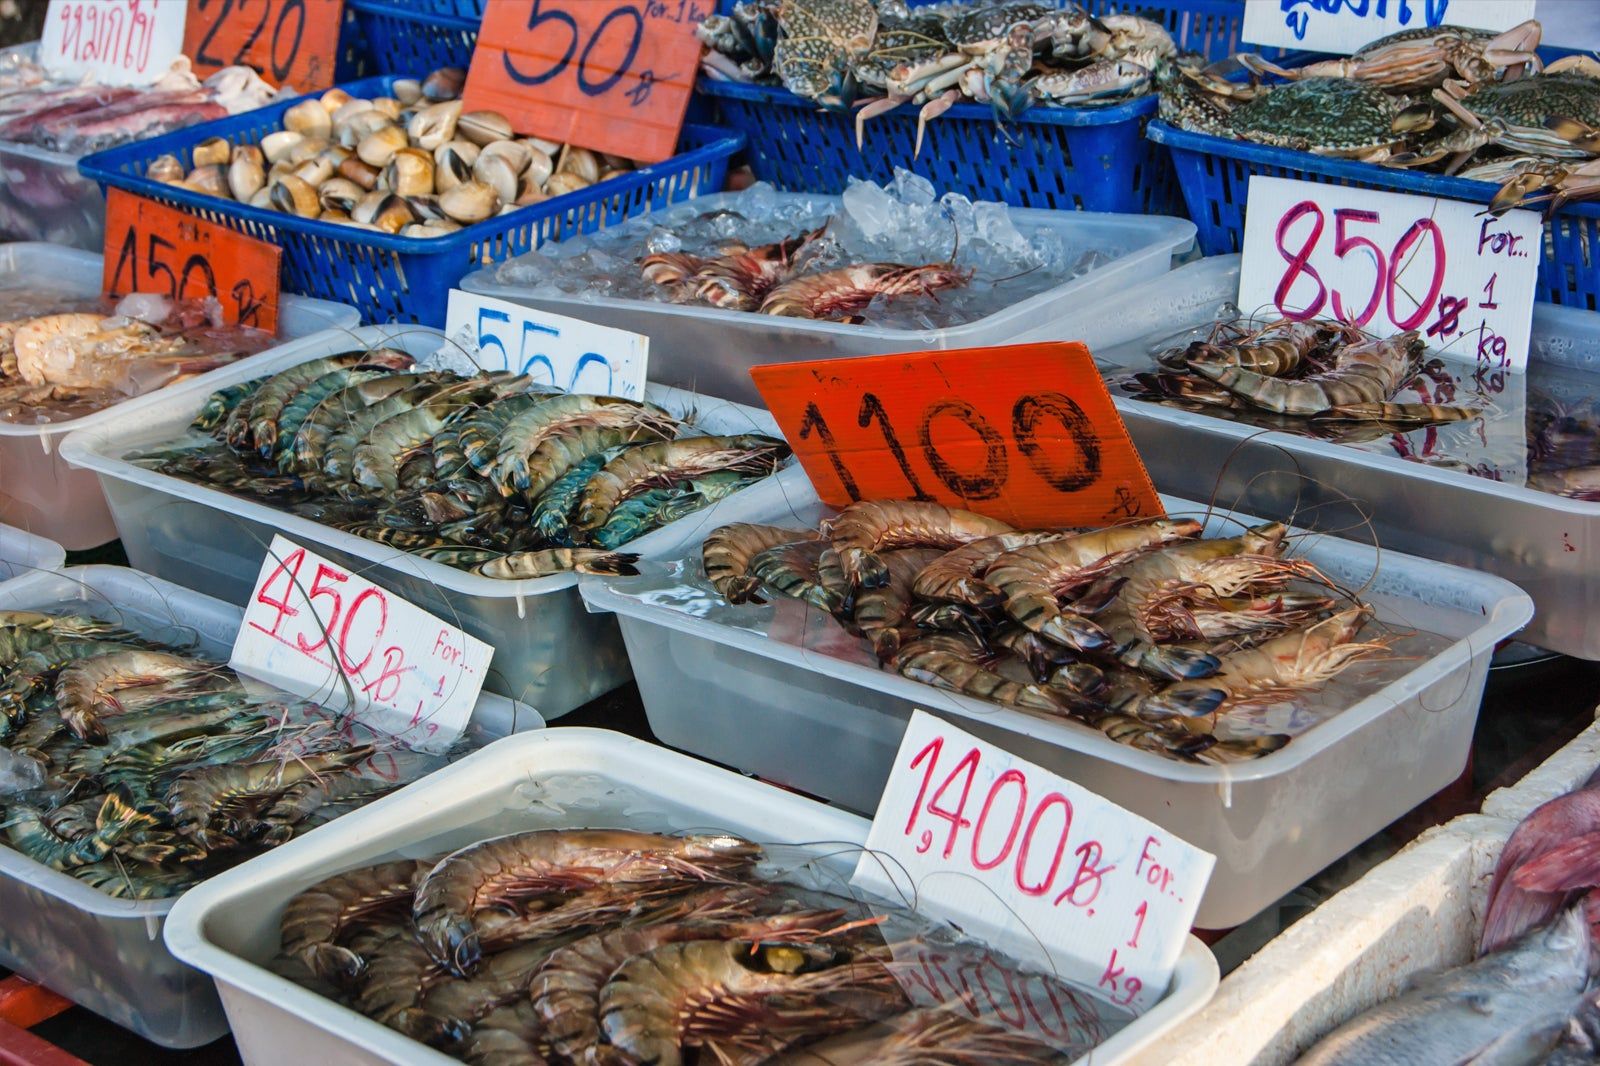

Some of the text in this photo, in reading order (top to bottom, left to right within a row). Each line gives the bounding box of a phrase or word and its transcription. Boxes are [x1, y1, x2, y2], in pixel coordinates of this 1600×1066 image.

[196, 0, 306, 83] 220
[503, 0, 644, 97] 50
[1274, 200, 1447, 332] 850
[1478, 272, 1499, 310] 1
[798, 391, 1103, 502] 1100
[256, 547, 390, 677] 450
[432, 674, 447, 699] 1
[1126, 899, 1150, 949] 1
